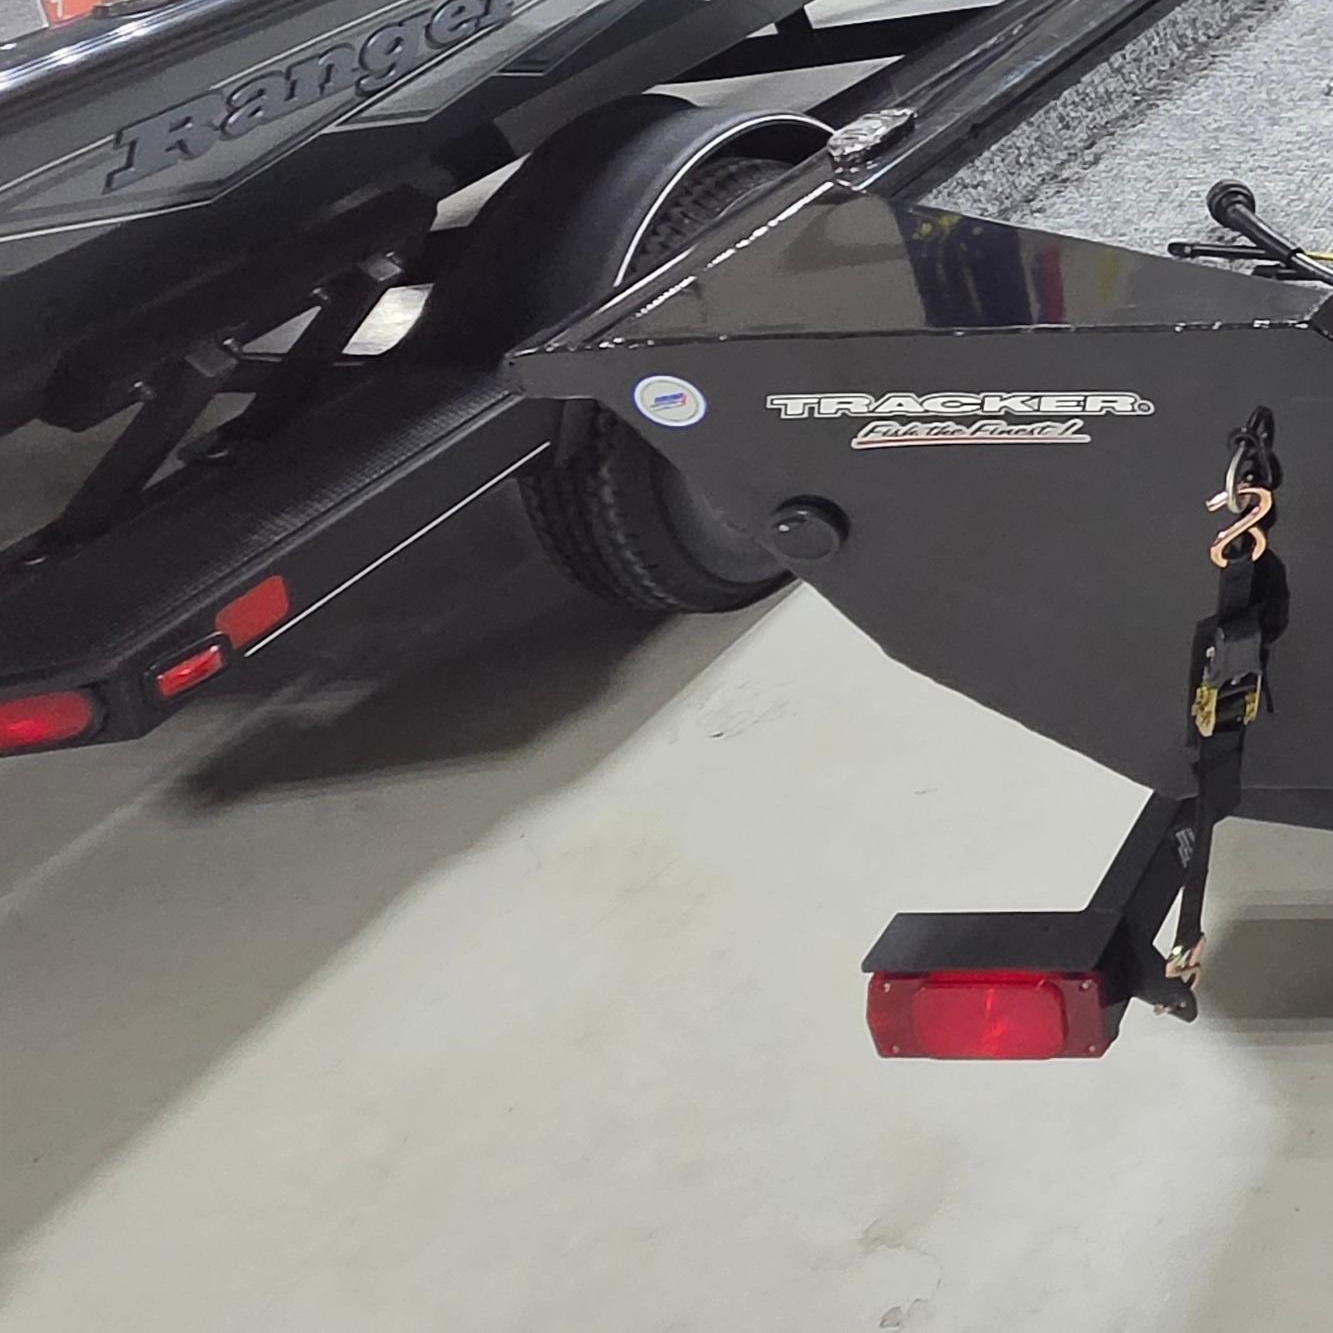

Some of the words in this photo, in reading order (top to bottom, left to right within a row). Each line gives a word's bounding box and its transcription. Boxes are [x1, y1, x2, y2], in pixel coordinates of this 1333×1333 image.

[767, 393, 1142, 417] TRACKER
[863, 421, 919, 438] Fish
[925, 422, 966, 436] the
